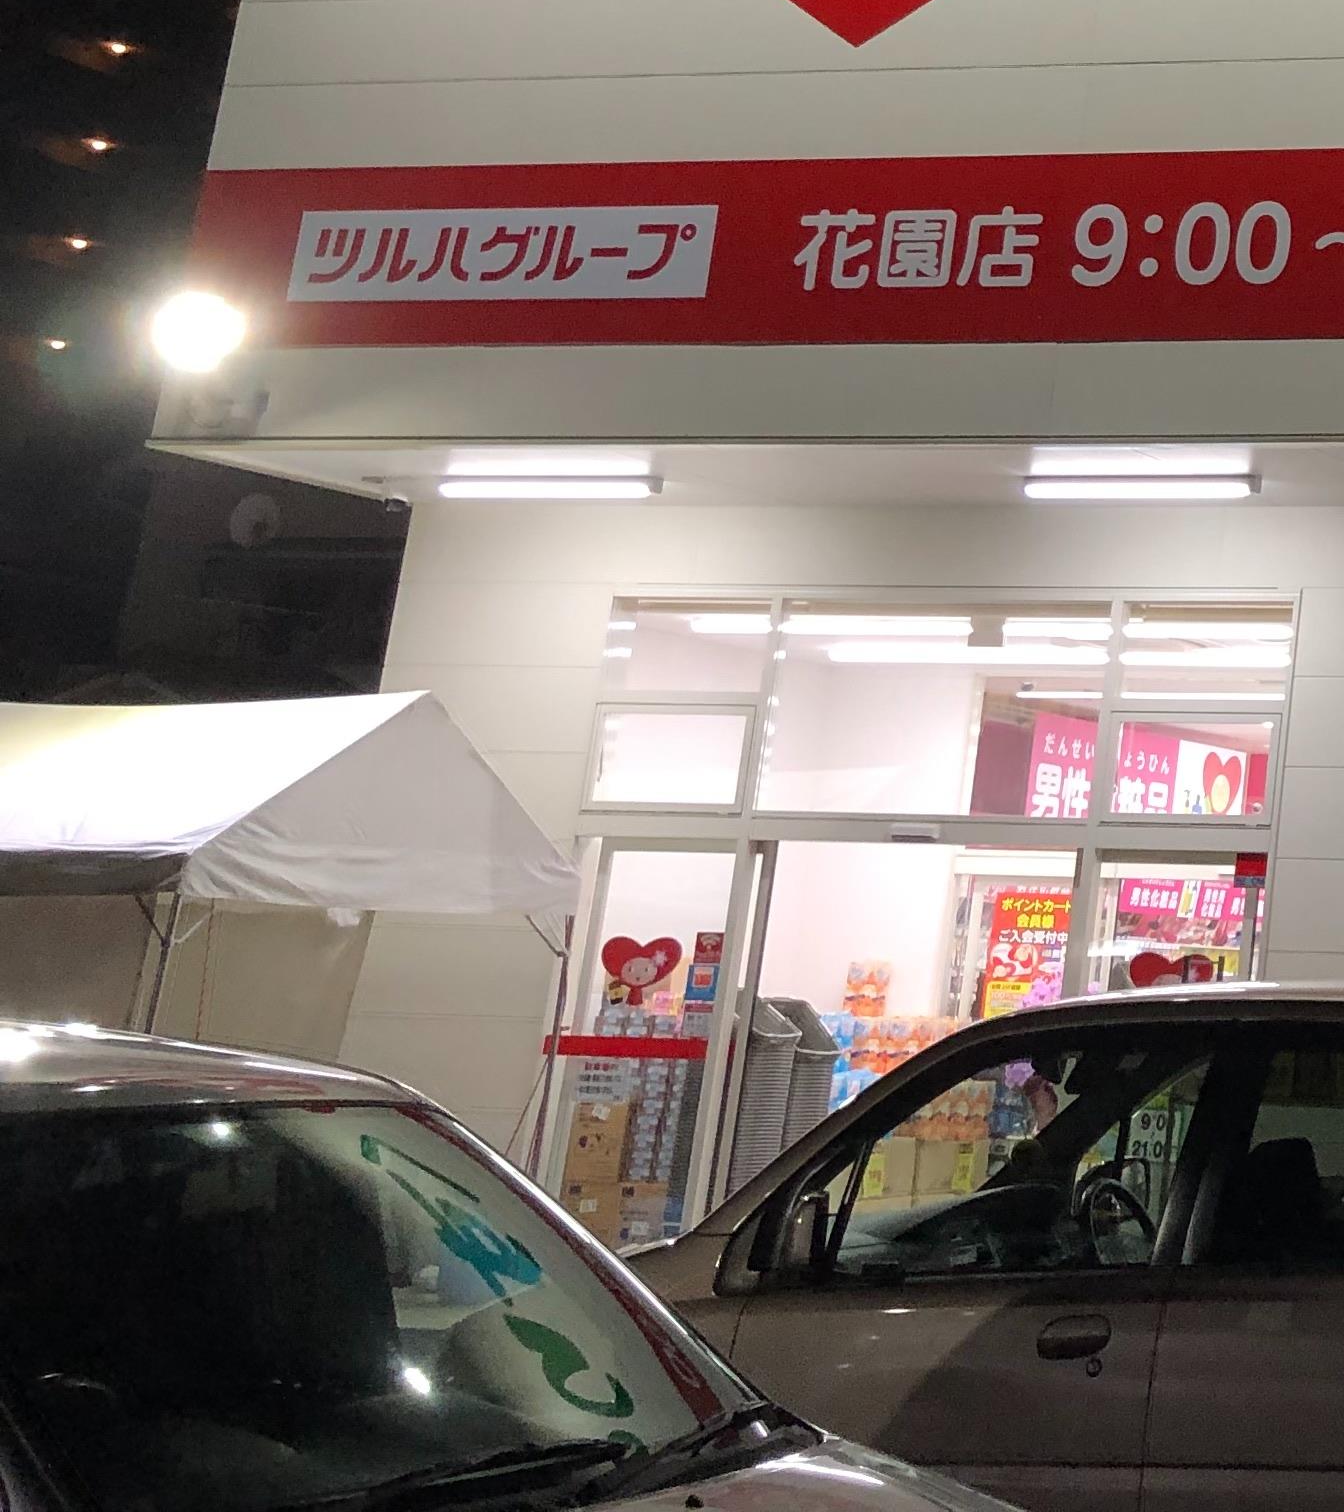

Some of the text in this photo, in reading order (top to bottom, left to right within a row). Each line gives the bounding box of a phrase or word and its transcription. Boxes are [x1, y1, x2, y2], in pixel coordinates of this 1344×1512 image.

[312, 223, 697, 282] ツルハグループ
[793, 206, 1043, 291] 花園店
